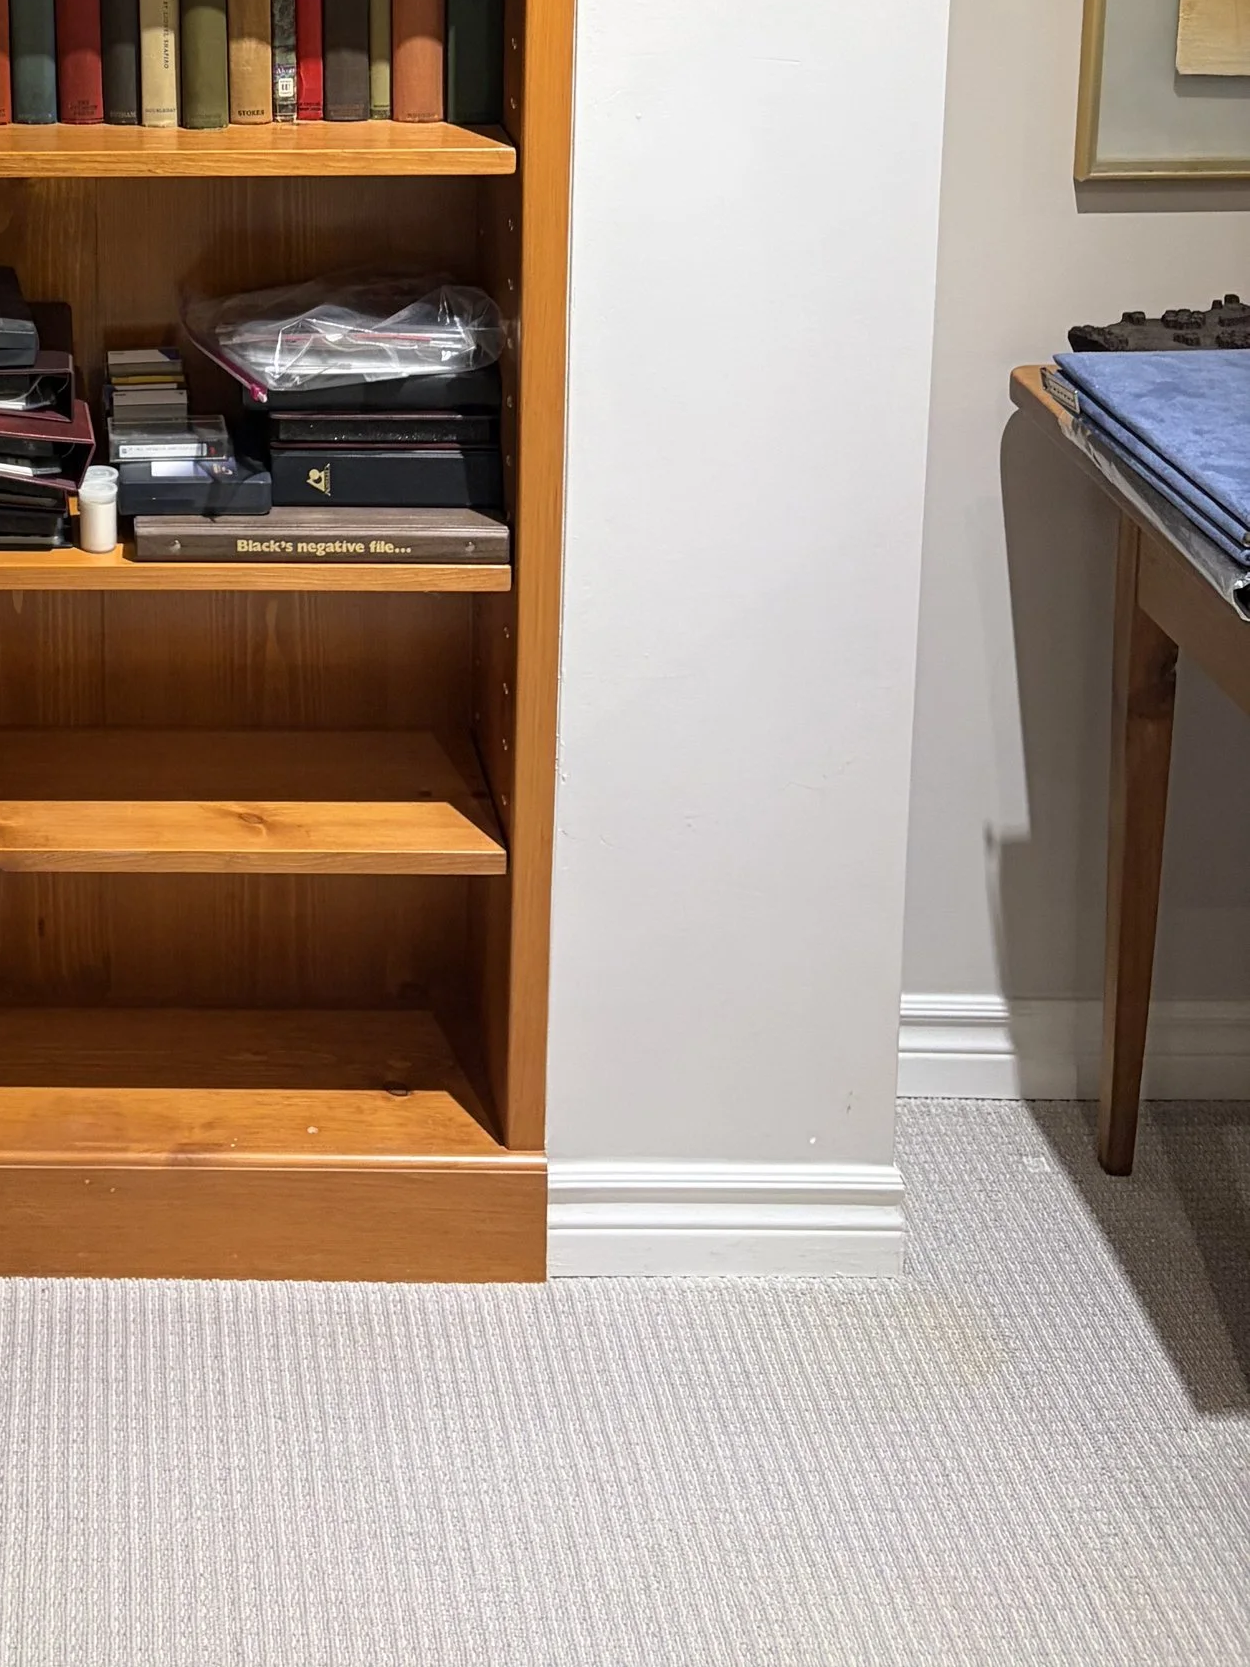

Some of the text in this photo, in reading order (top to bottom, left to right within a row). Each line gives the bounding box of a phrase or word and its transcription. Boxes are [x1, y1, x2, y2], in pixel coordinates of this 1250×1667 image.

[237, 109, 265, 117] STOKES
[236, 539, 412, 556] Black's negative file...
